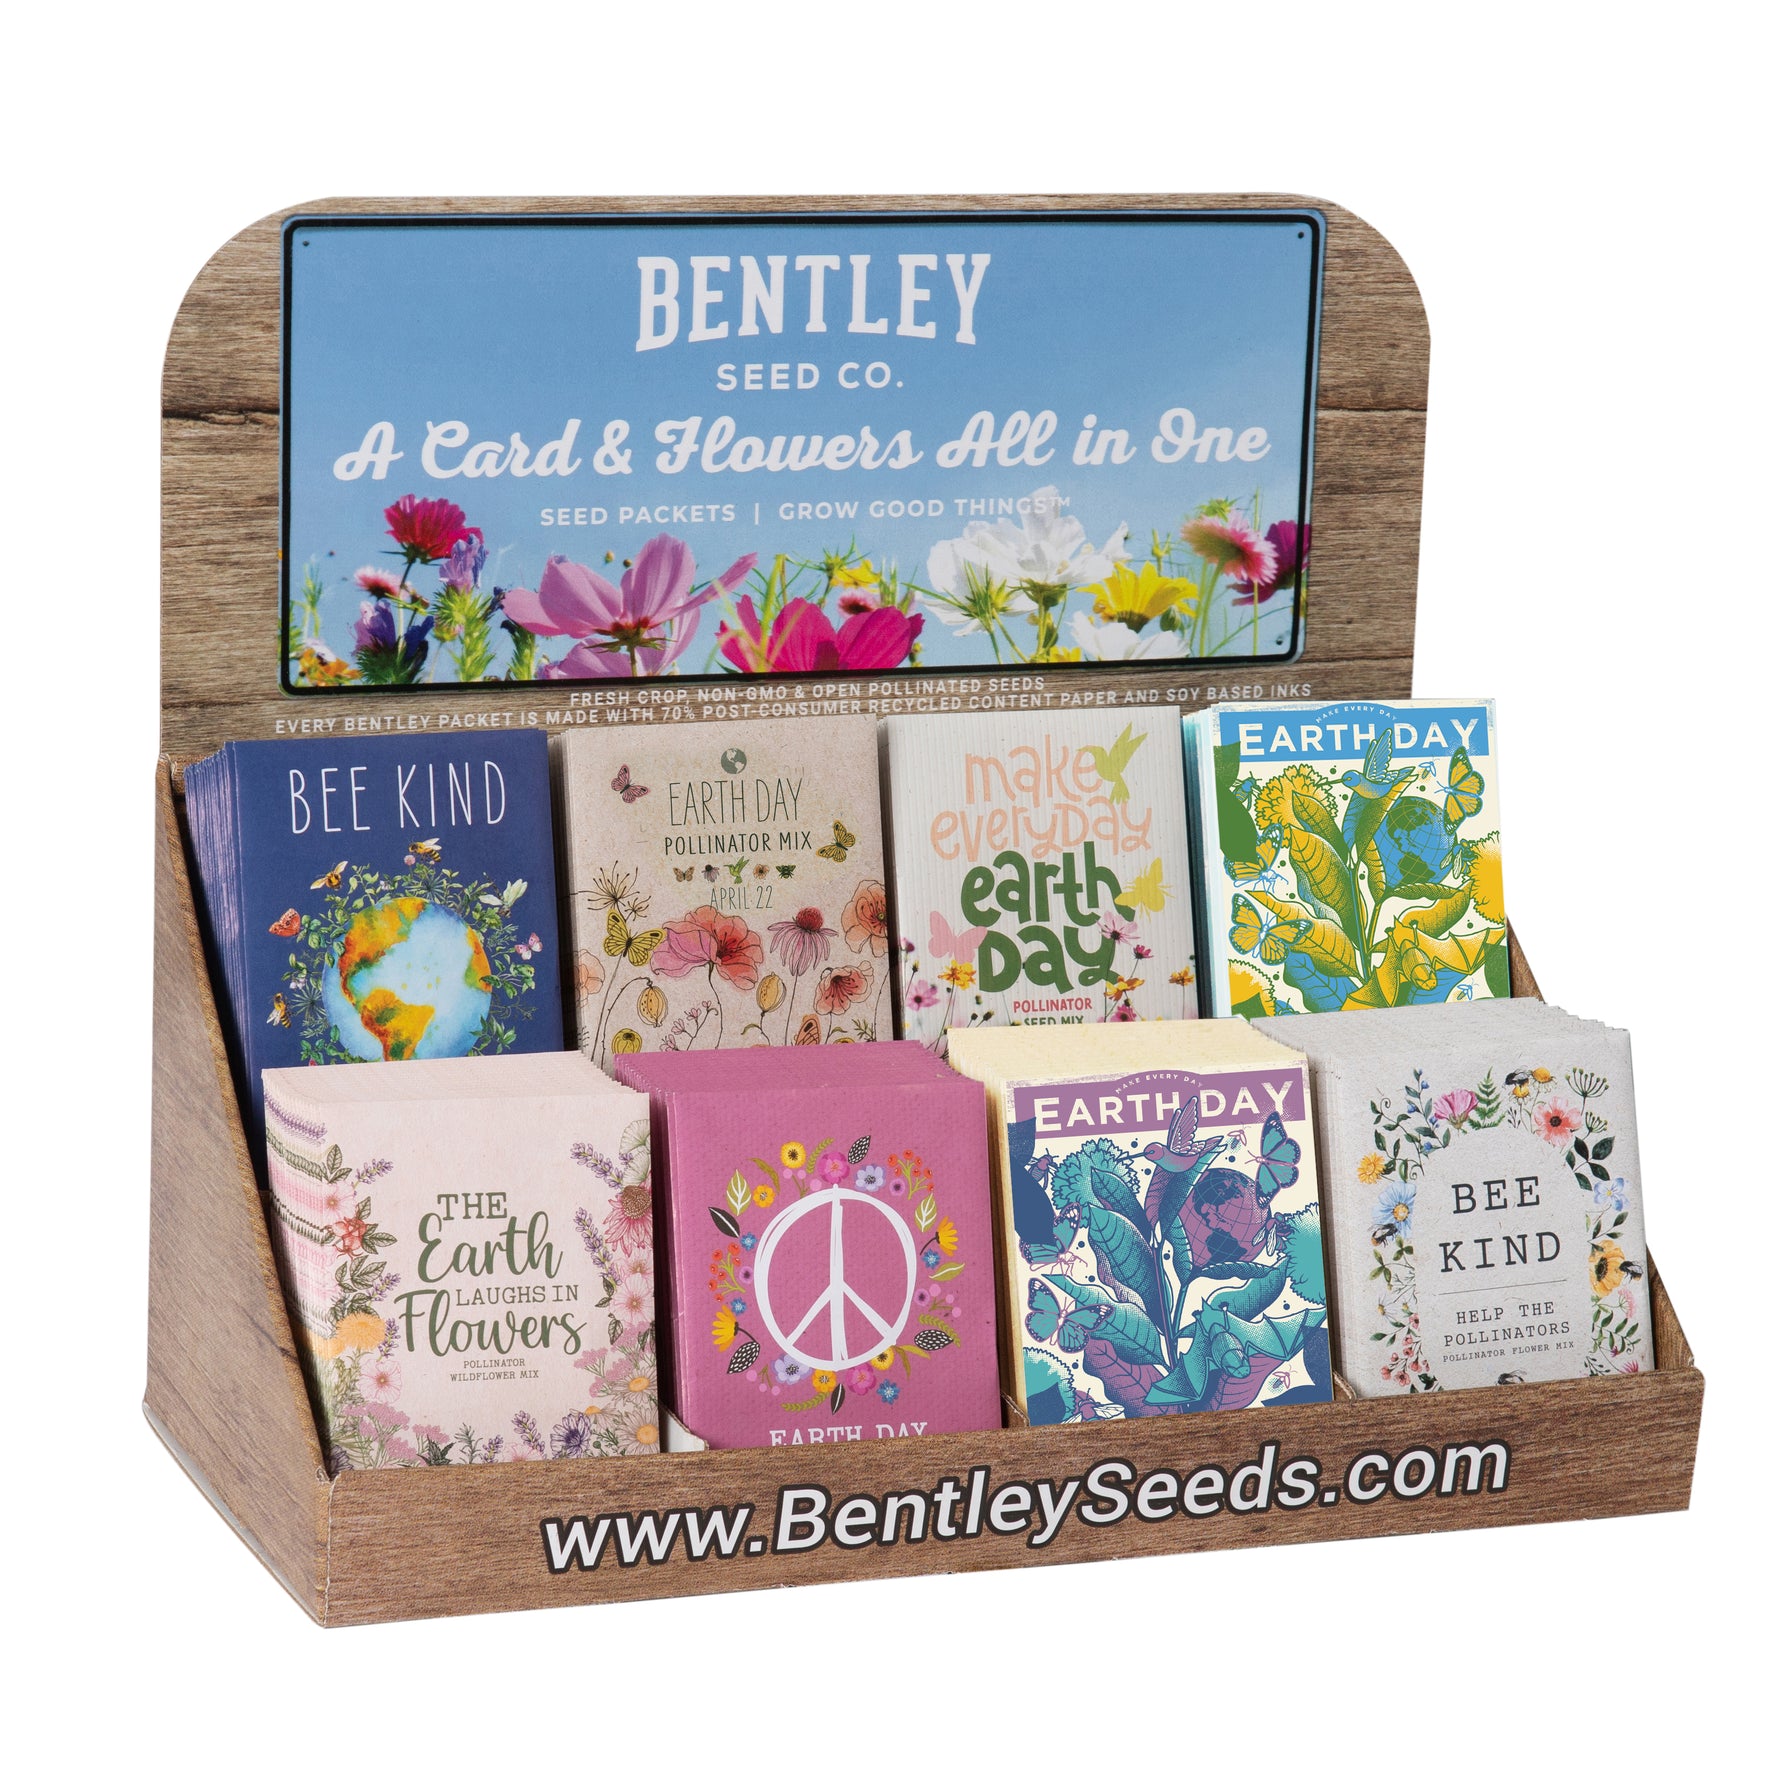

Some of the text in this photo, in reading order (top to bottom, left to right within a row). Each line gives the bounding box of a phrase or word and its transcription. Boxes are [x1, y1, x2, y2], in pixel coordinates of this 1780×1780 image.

[636, 253, 991, 352] BENTLEY
[716, 361, 903, 391] SEED CO.
[333, 407, 1272, 481] A Card & Flowers All in One
[540, 507, 608, 526] SEED
[618, 504, 736, 524] PACKETS
[779, 501, 859, 520] GROW
[869, 499, 944, 518] GOOD
[570, 677, 1045, 707] FRESH CROP, NON-GMO & OPEN POLLINATED SEEDS
[275, 683, 1312, 734] EVERY BENTLEY PACKET IS MADE WITH 70% POST-CONSUMER RECYCLED CONTENT PAPER AND SOY BASED INKS
[1238, 718, 1480, 756] EARTH DAY
[965, 734, 1103, 808] make
[289, 760, 506, 834] BEE KIND
[669, 778, 803, 826] EARTH DAY
[664, 831, 812, 856] POLLINATOR MIX
[710, 885, 773, 911] APRIL 22
[961, 841, 1136, 928] earth
[1013, 997, 1092, 1013] POLLINATOR
[1024, 1015, 1084, 1026] SEED MIX
[1145, 1073, 1178, 1081] EVERY
[1033, 1080, 1294, 1132] EARTH DAY
[437, 1192, 508, 1220] THE
[1451, 1176, 1541, 1214] BEE
[417, 1211, 563, 1283] Earth
[1438, 1231, 1561, 1273] KIND
[455, 1285, 579, 1306] LAUGHS IN
[394, 1289, 587, 1357] Flowers
[1456, 1302, 1555, 1324] HELP THE
[1444, 1321, 1570, 1347] POLLINATORS
[463, 1358, 526, 1369] POLLINATOR
[1442, 1340, 1574, 1363] POLLINATOR FLOWER MIX
[450, 1370, 540, 1382] WILDFLOWER MIX
[769, 1425, 863, 1447] EARTH
[543, 1437, 1509, 1572] www.BentleySeeds.com
